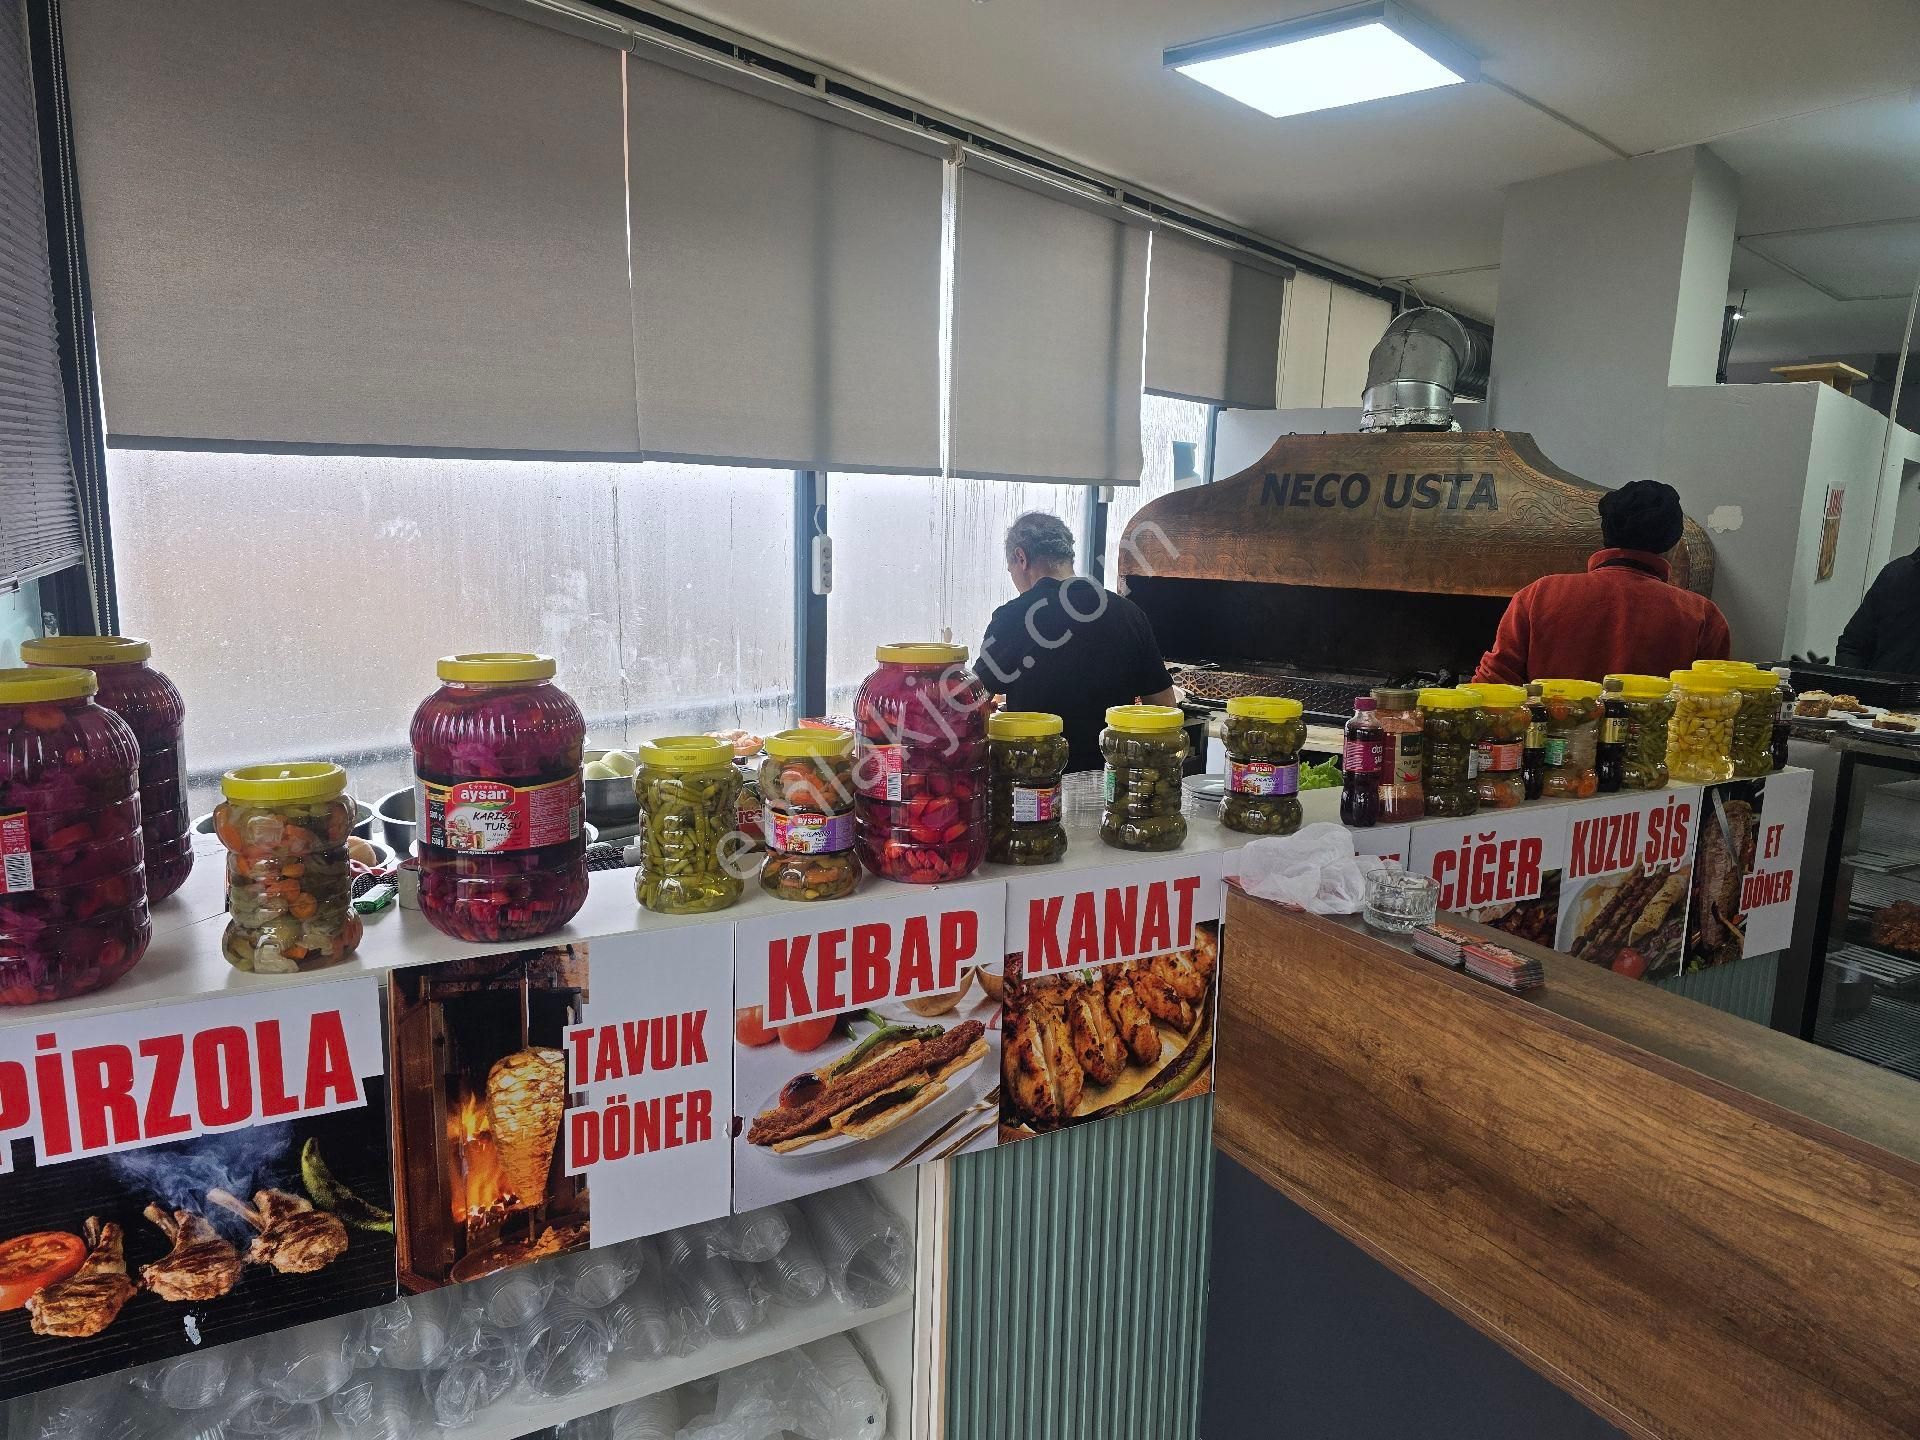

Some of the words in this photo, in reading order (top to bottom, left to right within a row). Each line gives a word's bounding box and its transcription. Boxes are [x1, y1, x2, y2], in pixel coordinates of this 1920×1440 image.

[1260, 472, 1371, 509] NECO
[1383, 473, 1499, 511] USTA
[460, 789, 507, 803] aysan
[473, 811, 520, 822] KARIŞIK
[485, 822, 522, 833] TURŞU
[1569, 811, 1640, 878] KUZU
[1644, 795, 1691, 873] ŞİŞ
[1763, 823, 1785, 859] ET
[1741, 869, 1794, 912] DÖNER
[1027, 877, 1200, 974] KANAT
[768, 911, 978, 1021] KEBAP
[570, 1009, 709, 1086] TAVUK
[571, 1089, 712, 1168] DÖNER
